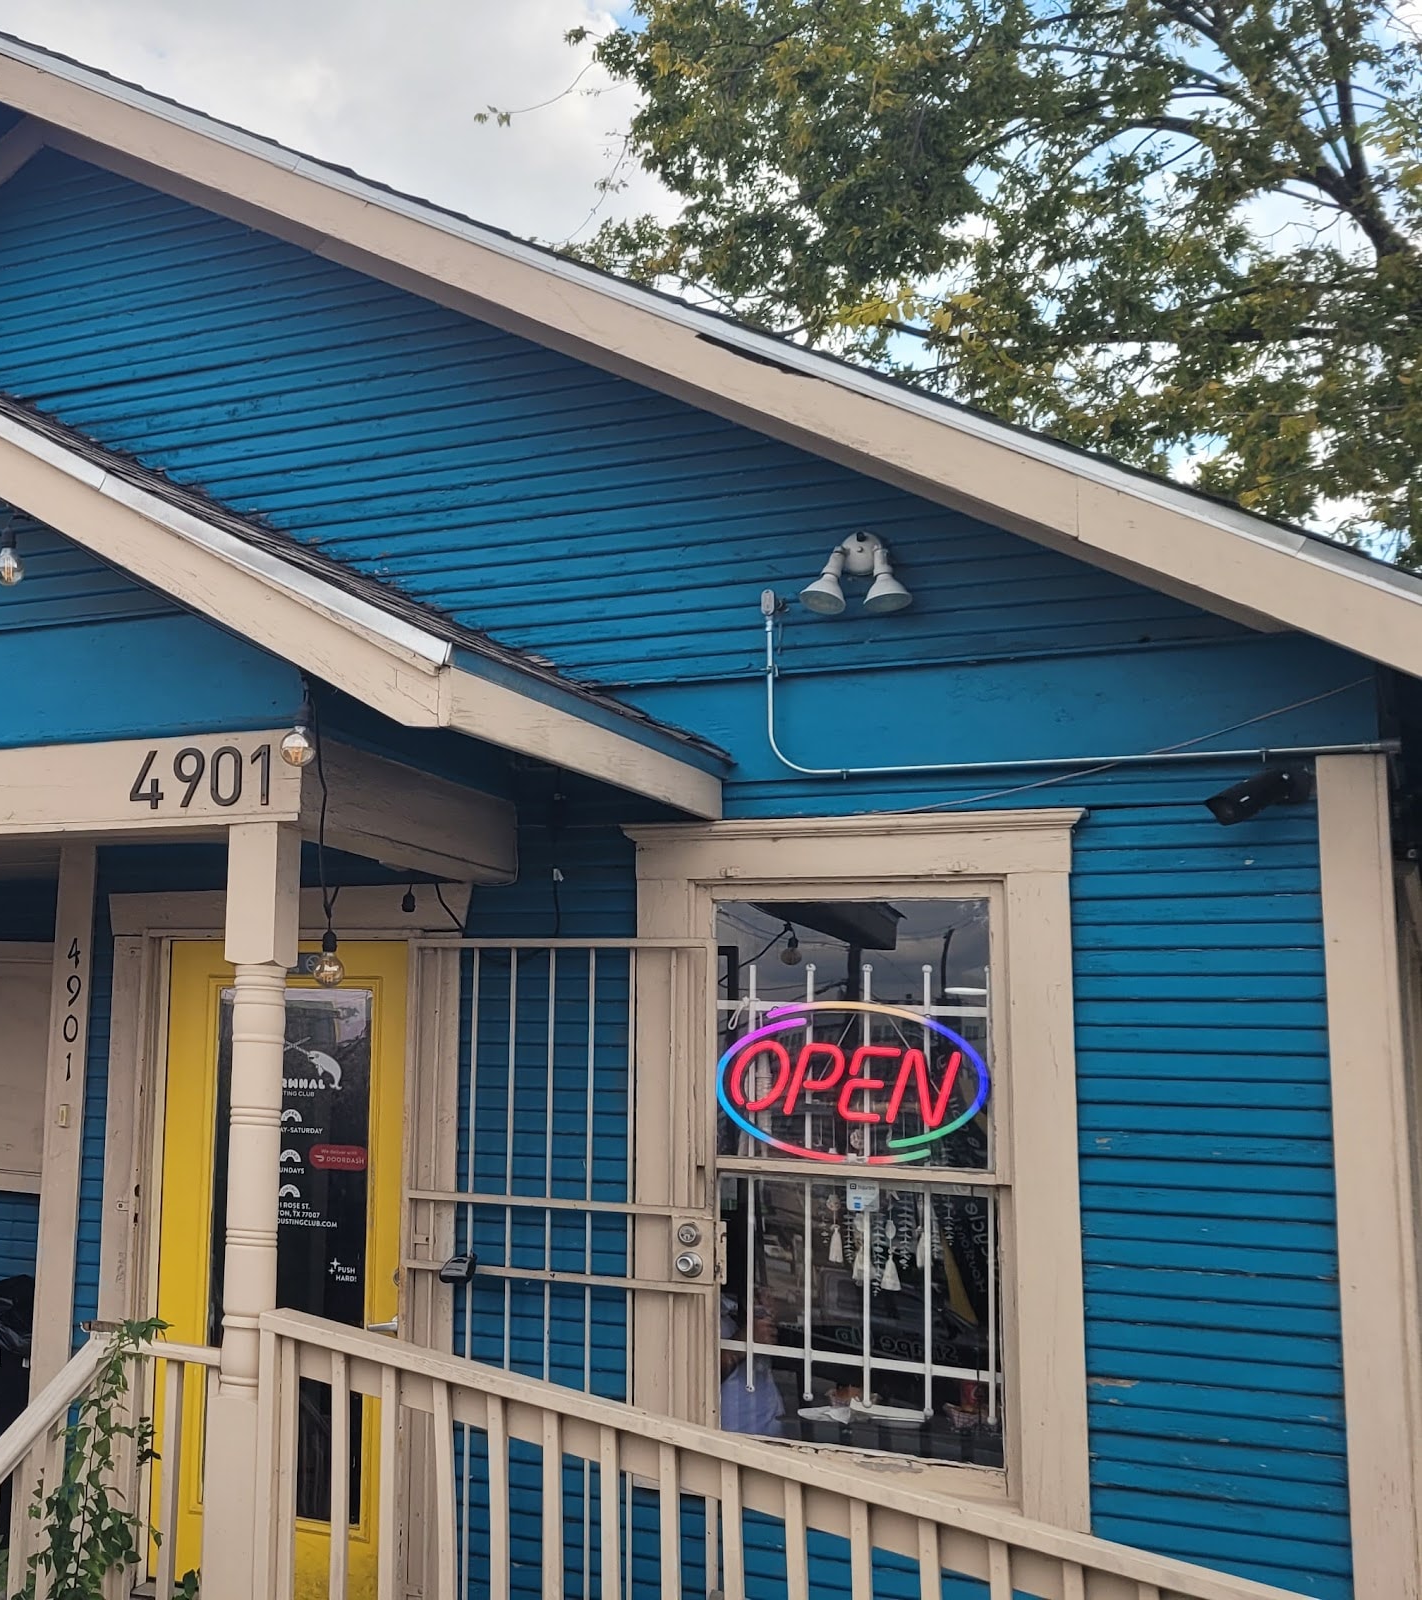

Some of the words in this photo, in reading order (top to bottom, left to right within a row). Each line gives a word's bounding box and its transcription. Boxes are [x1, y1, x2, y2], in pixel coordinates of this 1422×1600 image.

[130, 743, 271, 809] 4901
[63, 937, 81, 1081] 4901
[282, 1078, 325, 1089] RWHAL
[730, 1040, 962, 1128] OPEN
[283, 1202, 300, 1210] ROSE
[302, 1211, 320, 1219] 77007
[277, 1219, 338, 1228] OUSTINGCLUB.COM
[336, 1275, 357, 1283] HARD!
